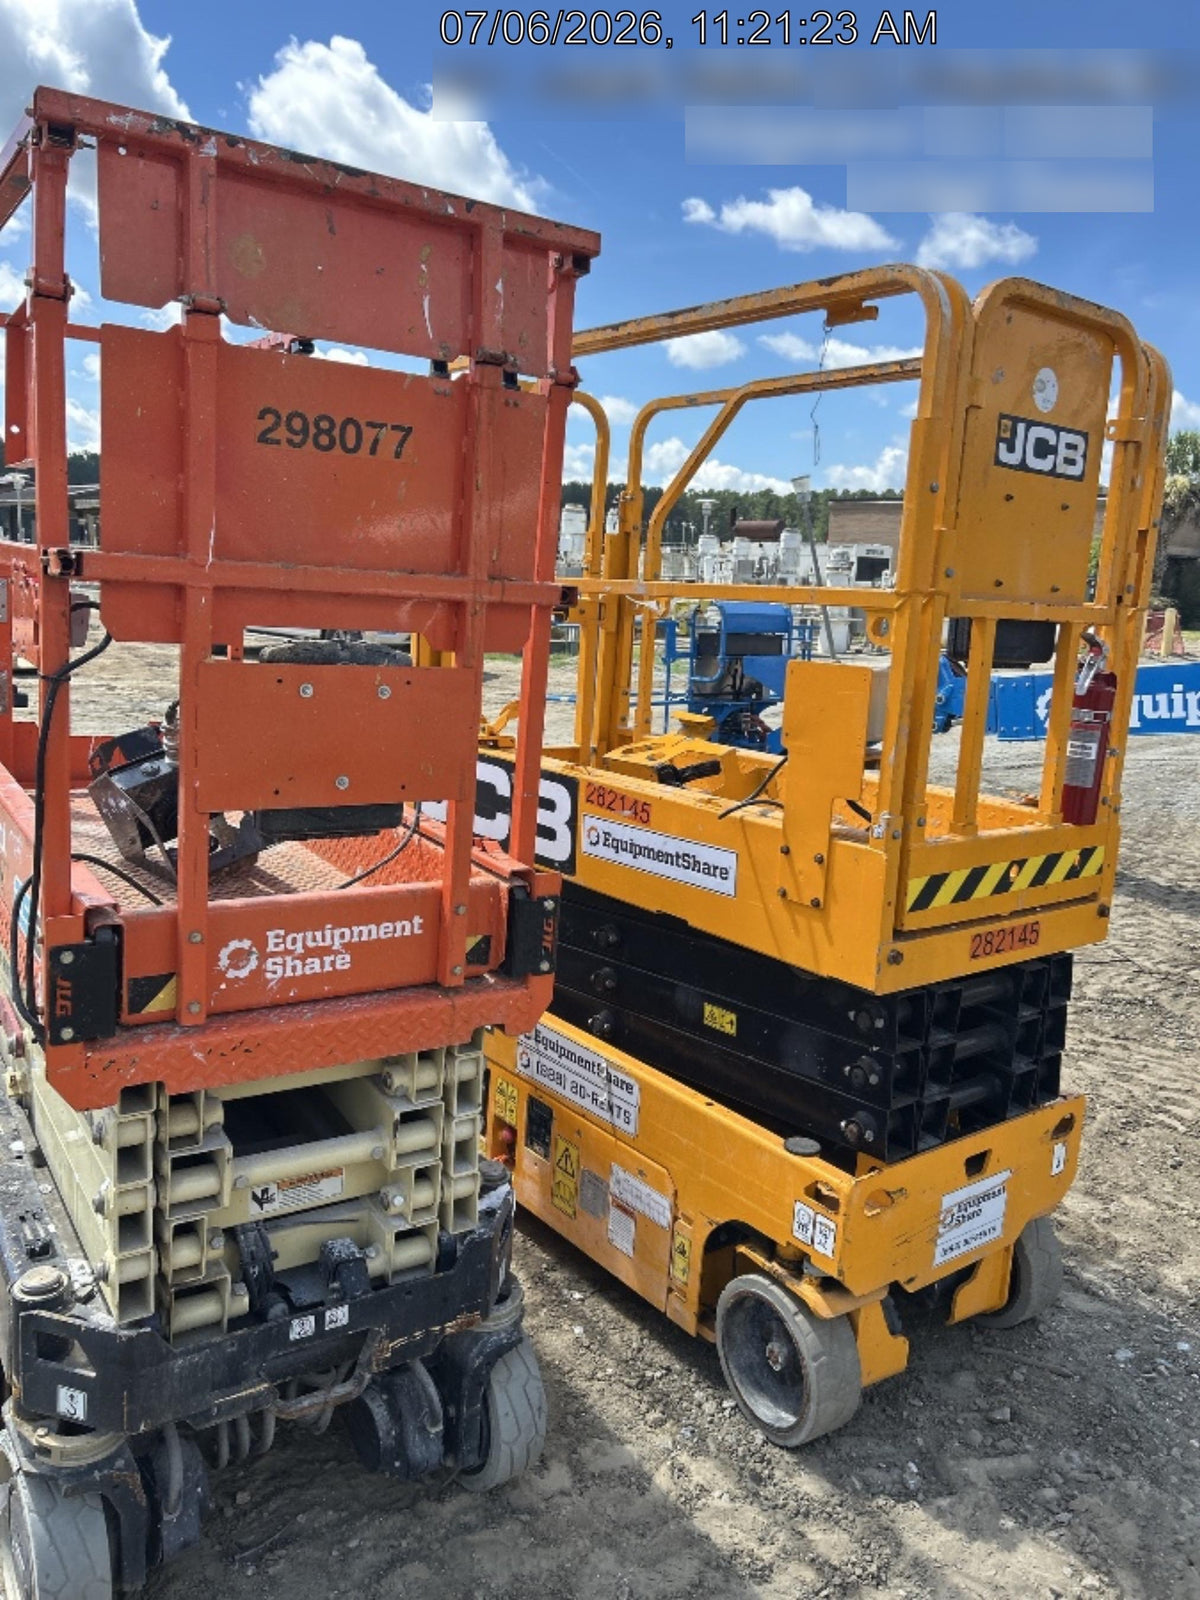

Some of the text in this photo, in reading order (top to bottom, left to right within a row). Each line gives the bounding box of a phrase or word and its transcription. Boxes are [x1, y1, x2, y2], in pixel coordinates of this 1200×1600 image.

[257, 406, 413, 459] 298077
[998, 422, 1086, 476] JCB
[421, 760, 572, 862] CB
[586, 782, 652, 824] 282145
[602, 830, 730, 881] EquipmentShare
[266, 915, 424, 954] Equipment
[970, 920, 1040, 959] 282145
[264, 953, 351, 981] Share
[55, 975, 73, 1017] JLG
